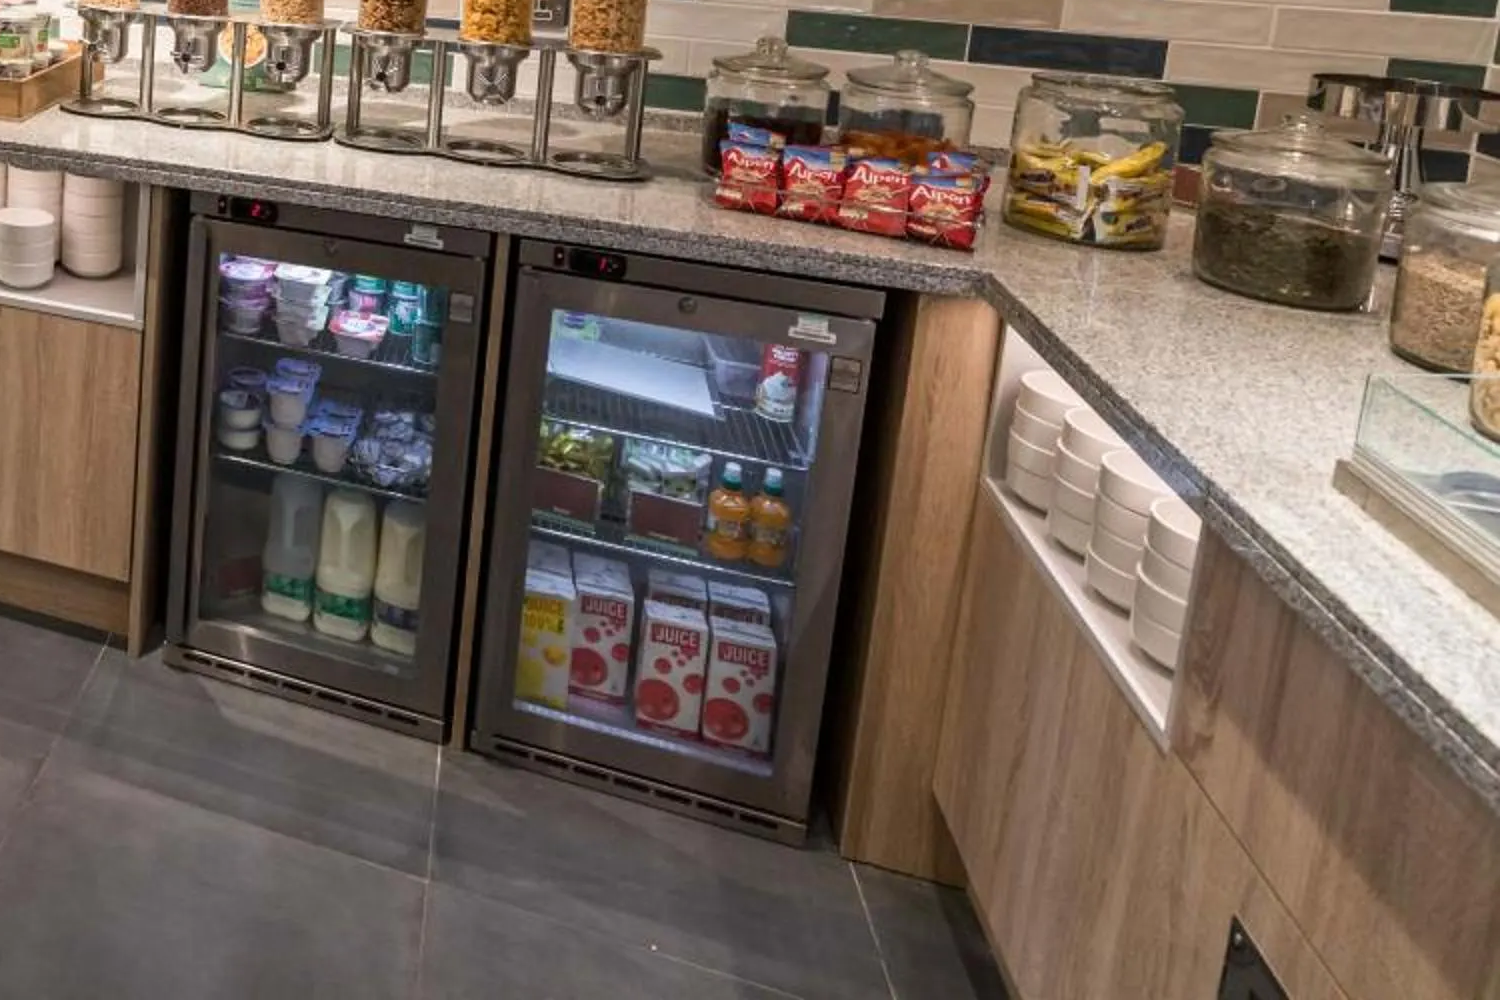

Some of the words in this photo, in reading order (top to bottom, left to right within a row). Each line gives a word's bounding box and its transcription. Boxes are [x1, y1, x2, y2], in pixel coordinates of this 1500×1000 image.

[727, 151, 775, 171] Alpen
[787, 161, 838, 182] Alpen
[847, 165, 909, 185] Alpen
[910, 184, 973, 205] Alpen
[585, 599, 626, 618] JUICE
[655, 626, 698, 648] JUICE
[723, 646, 769, 667] JUICE
